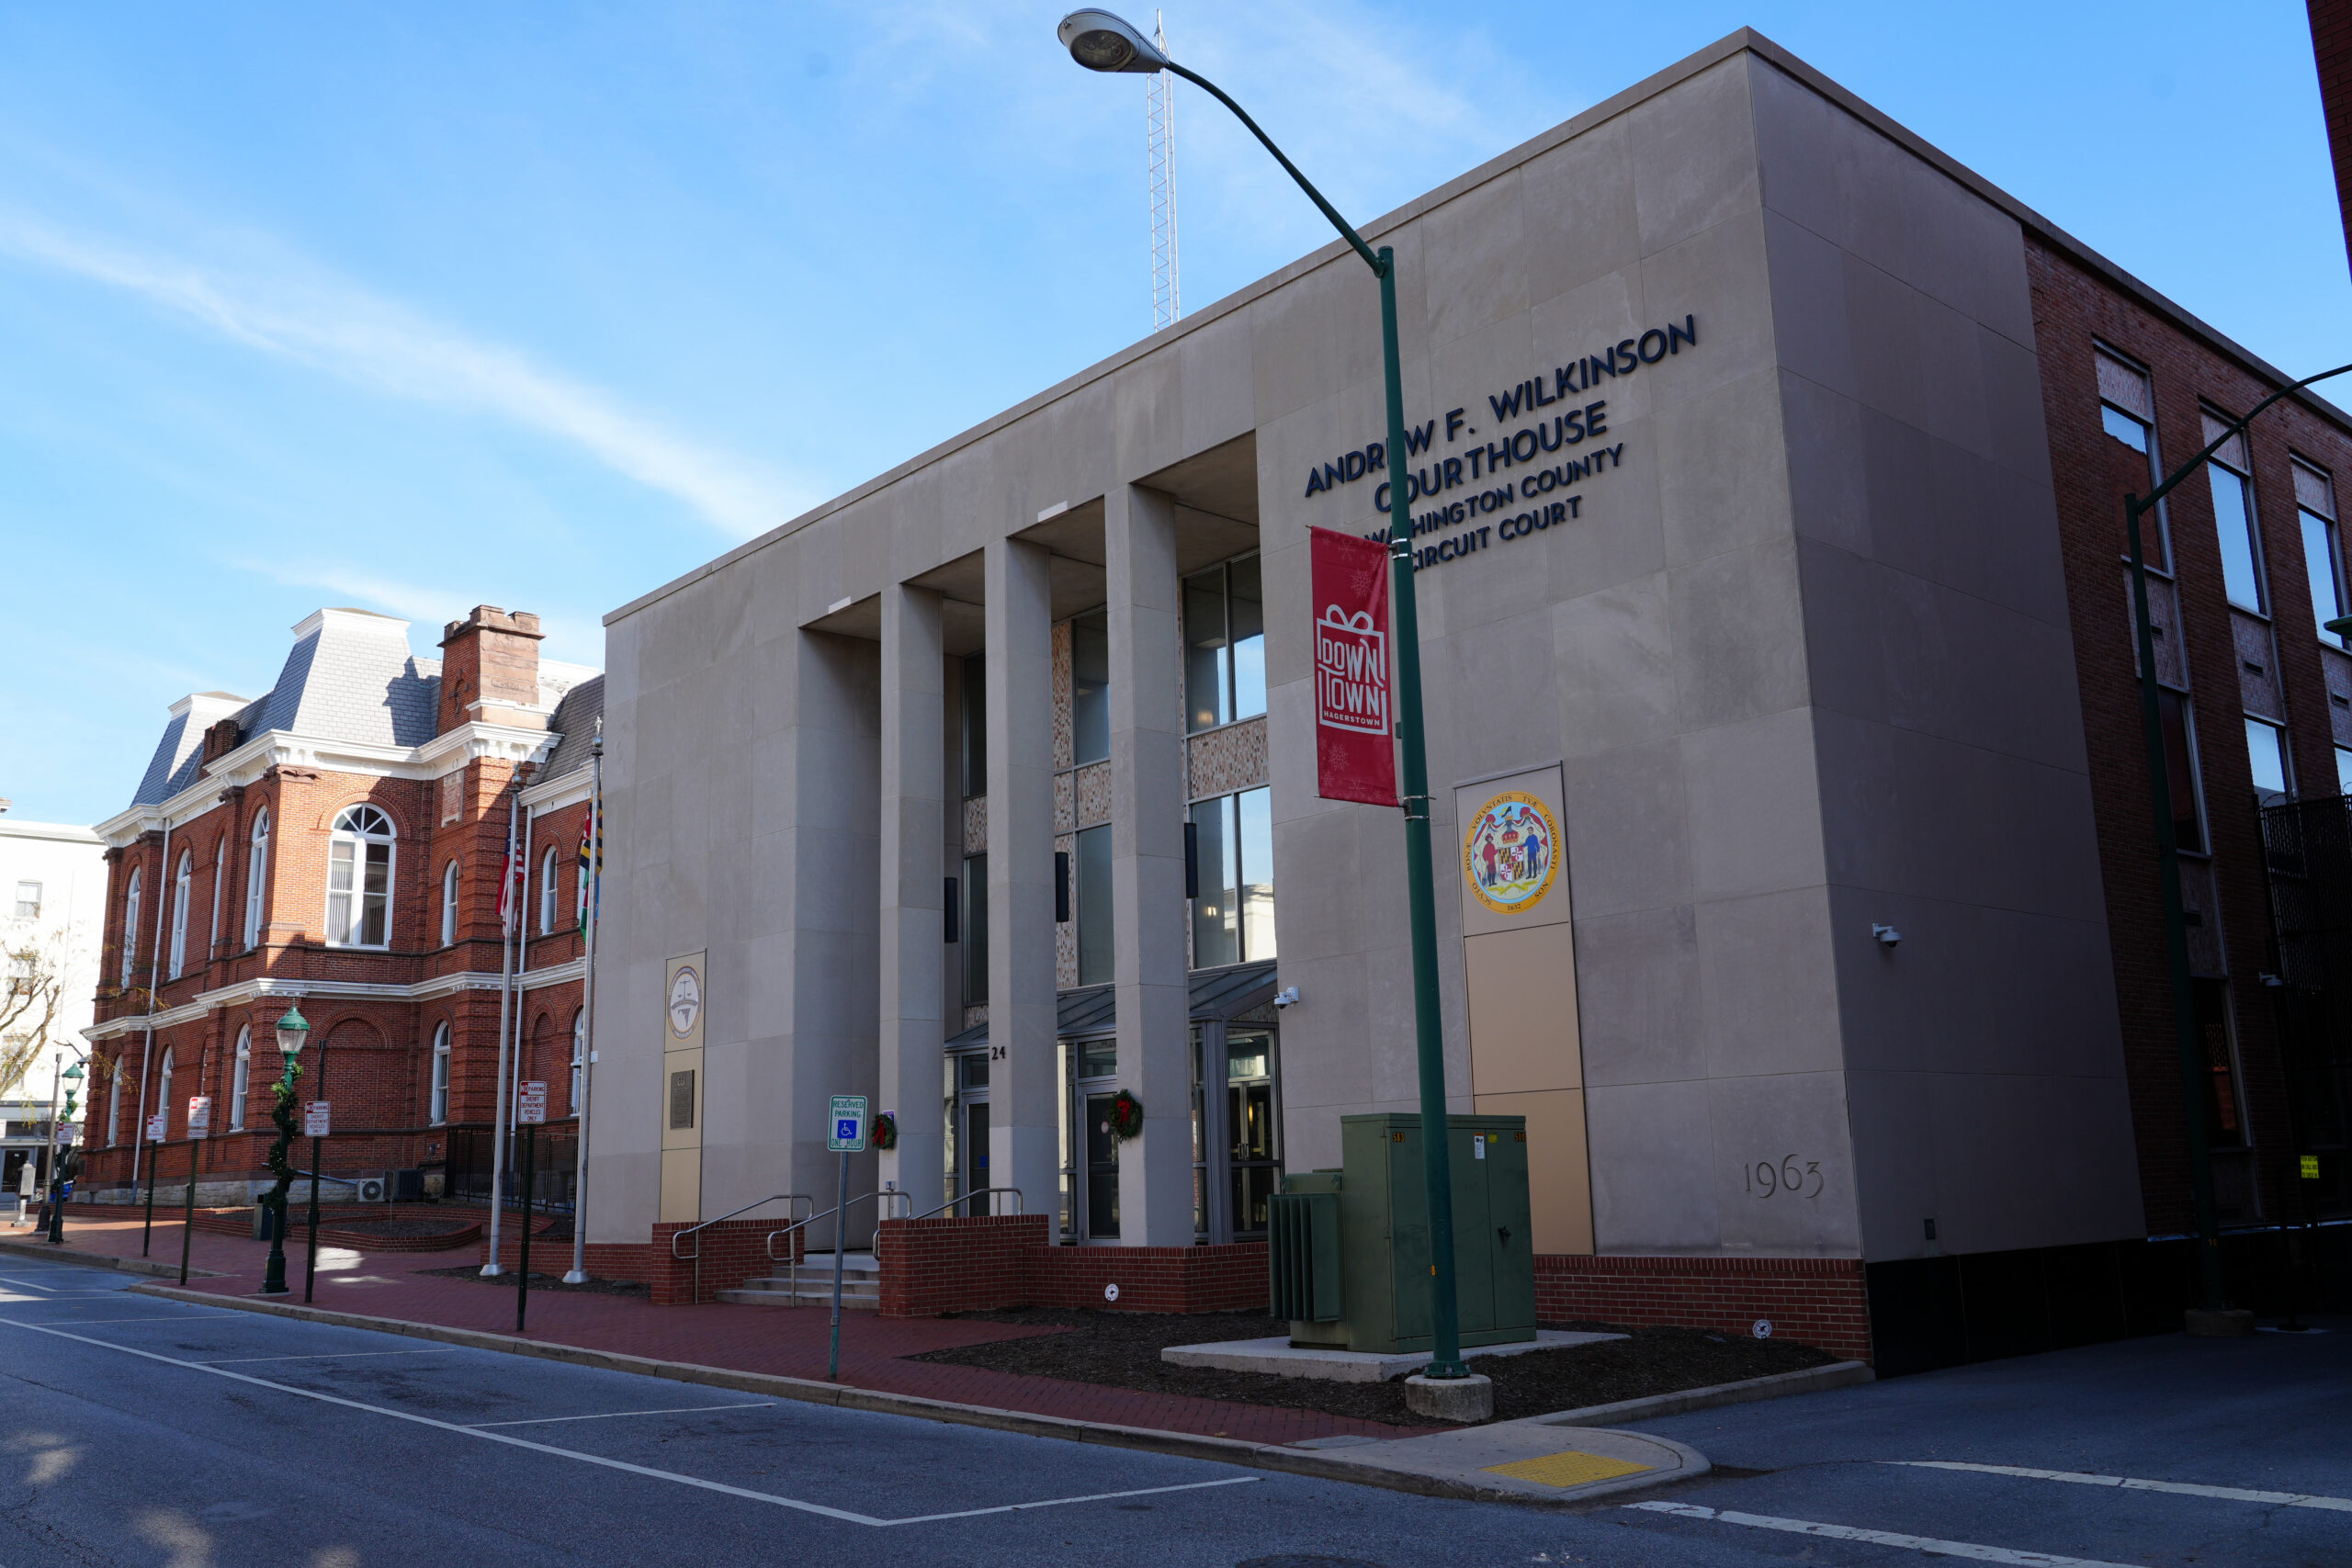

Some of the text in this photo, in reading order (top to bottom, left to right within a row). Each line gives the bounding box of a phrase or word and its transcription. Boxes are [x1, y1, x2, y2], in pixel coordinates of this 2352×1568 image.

[1306, 313, 1696, 498] ANDRW F. WILKINSON
[1364, 443, 1623, 545] WHINGTON COUNTY
[1412, 495, 1582, 571] IRCUIT COURT
[1322, 637, 1384, 687] DOWN
[1318, 663, 1380, 716] TOWN
[1324, 709, 1380, 727] HAGERSTOWN
[991, 1045, 1006, 1060] 24
[1744, 1154, 1825, 1199] 1963
